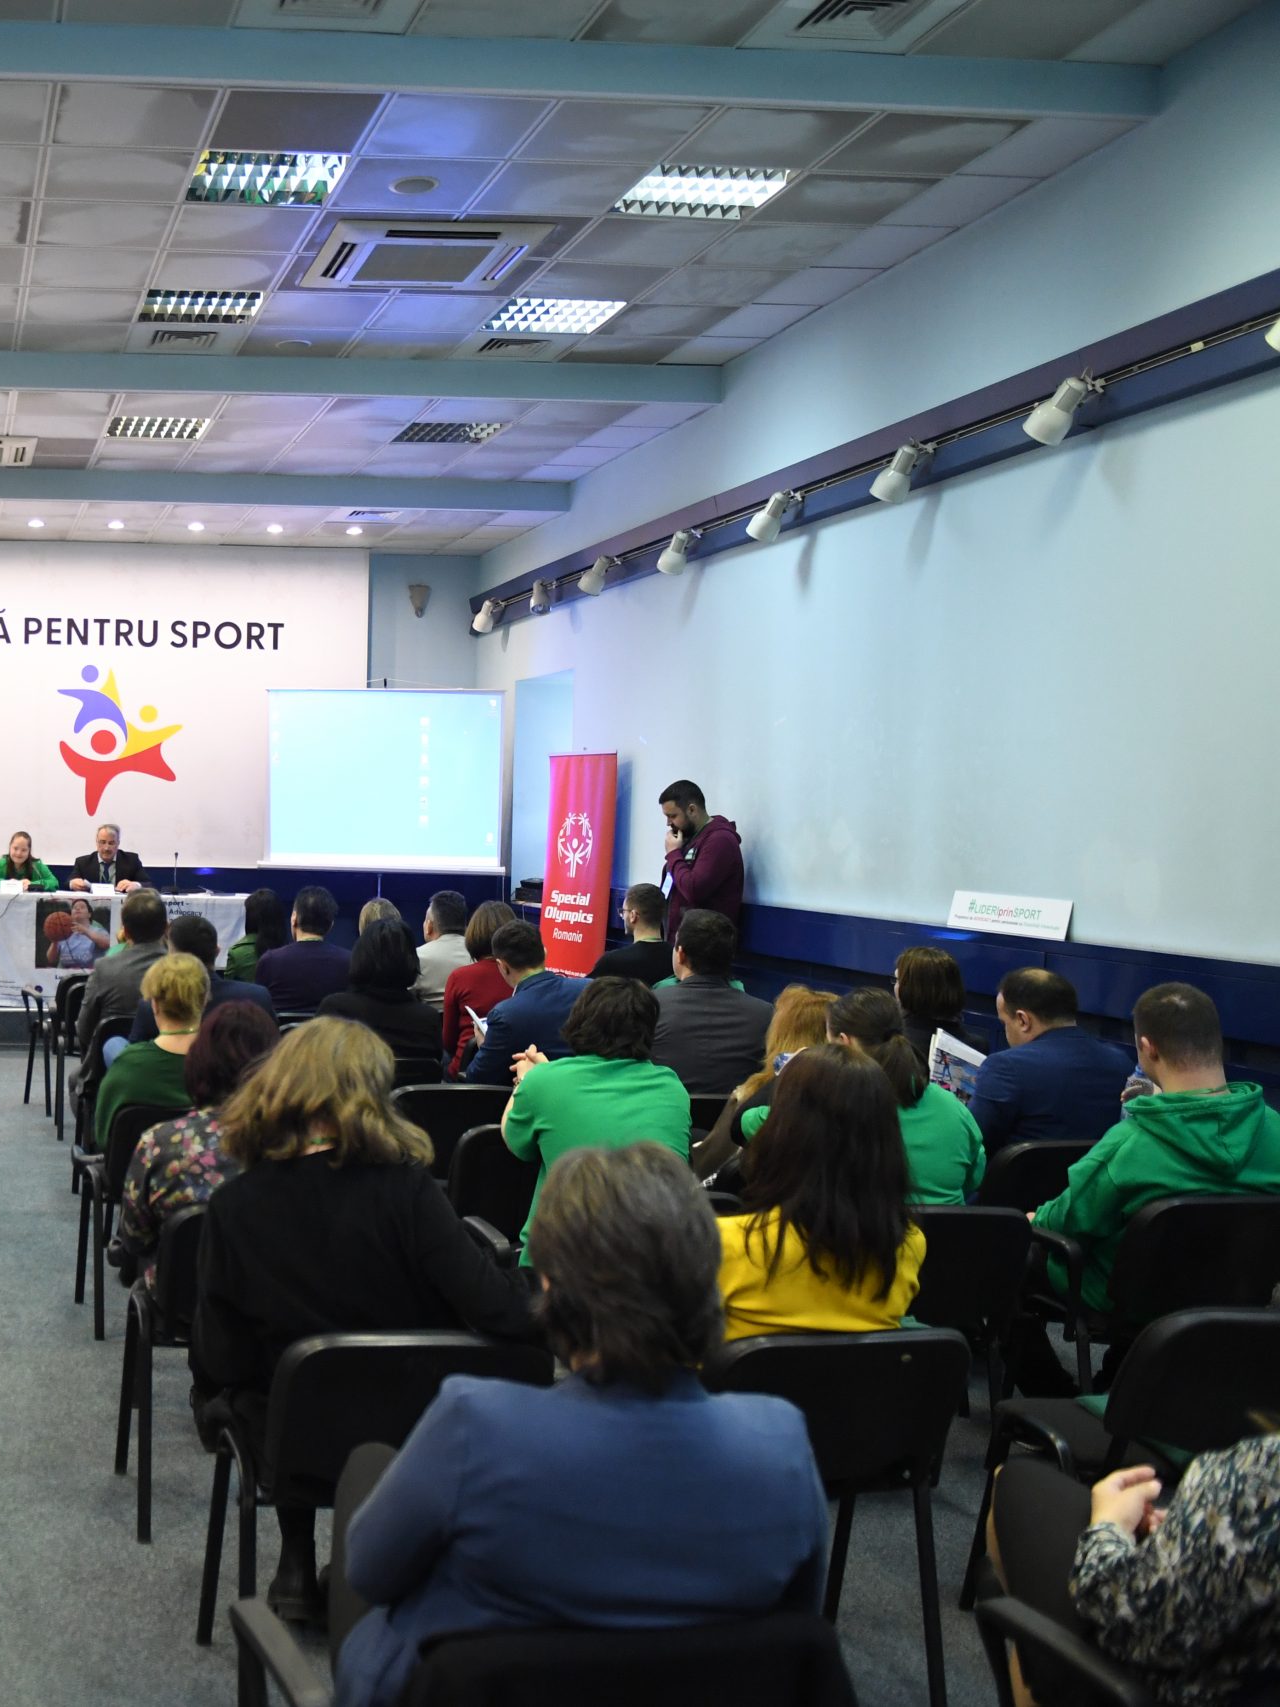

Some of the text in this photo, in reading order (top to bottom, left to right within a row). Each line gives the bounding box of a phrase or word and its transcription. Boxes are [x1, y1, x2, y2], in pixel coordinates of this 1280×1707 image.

[23, 616, 159, 648] PENTRU
[170, 620, 285, 650] SPORT
[551, 891, 590, 906] Special
[169, 909, 202, 917] Advocacy
[545, 907, 593, 924] Olympics
[553, 929, 583, 942] Romania
